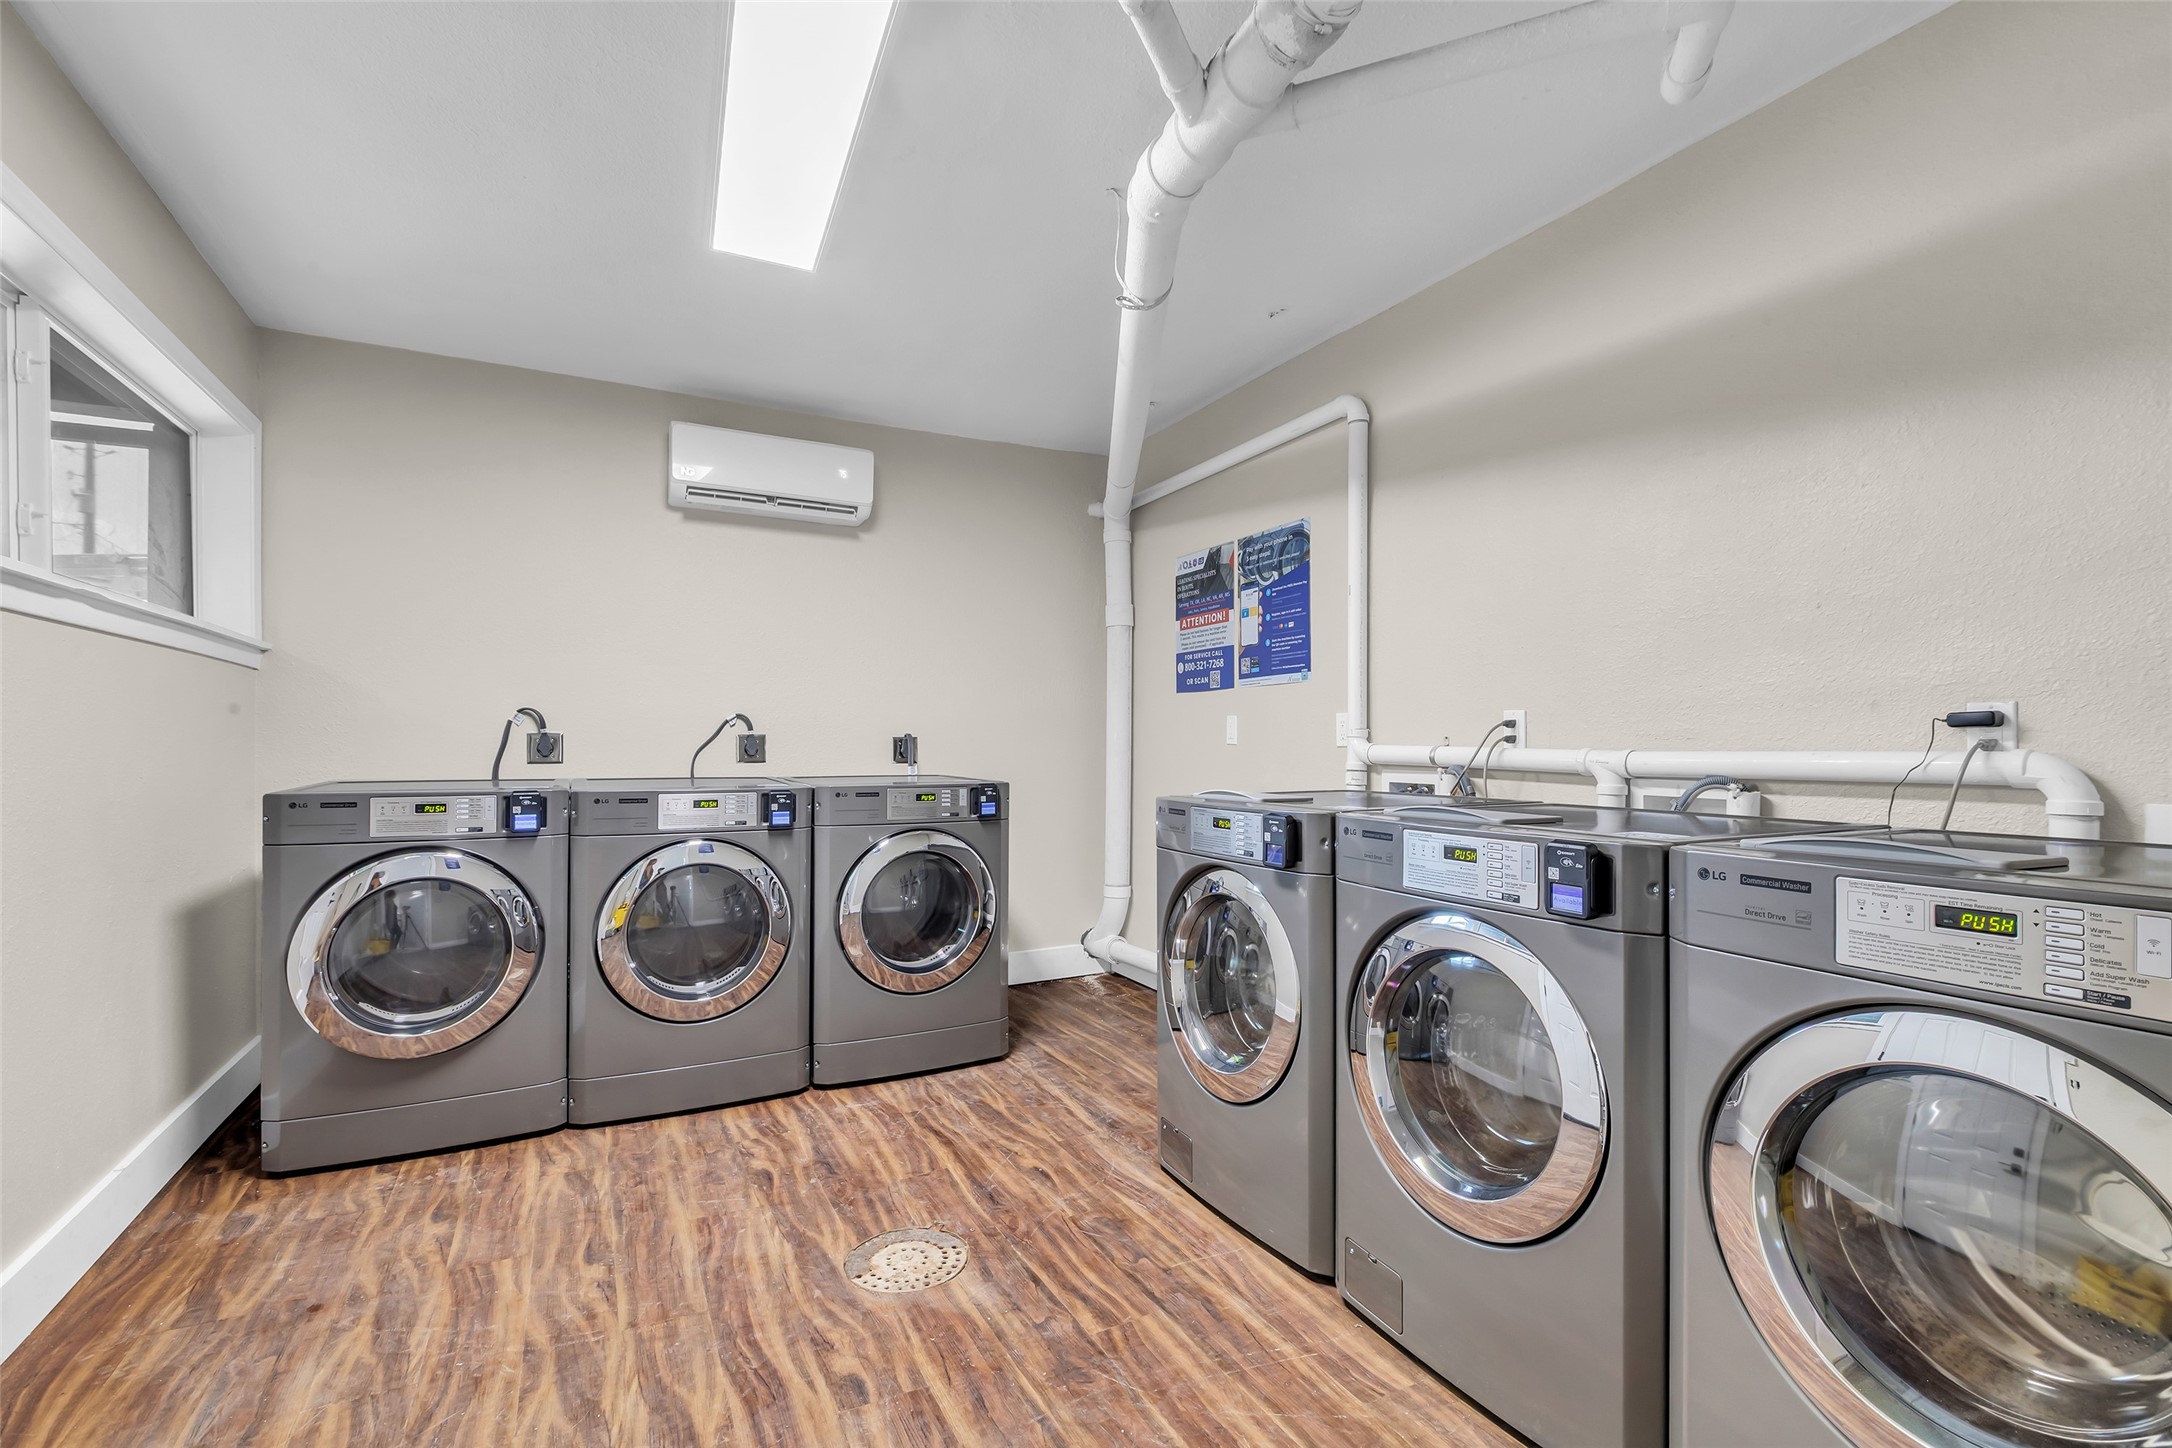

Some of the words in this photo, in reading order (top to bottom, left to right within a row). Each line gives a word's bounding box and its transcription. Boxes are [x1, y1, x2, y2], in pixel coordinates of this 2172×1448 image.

[1274, 536, 1287, 545] phone
[1181, 611, 1226, 629] ATTENTION!
[1185, 658, 1224, 671] 800-321-7268
[1454, 849, 1477, 861] PUSH
[1742, 876, 1780, 888] Commercial
[1782, 881, 1809, 891] Washer
[1974, 903, 2003, 911] Remaining
[1745, 908, 1766, 918] Direct
[1767, 912, 1787, 921] Drive
[1960, 914, 2014, 932] PUSH
[2090, 957, 2122, 966] Delicates
[2129, 976, 2150, 984] Wash
